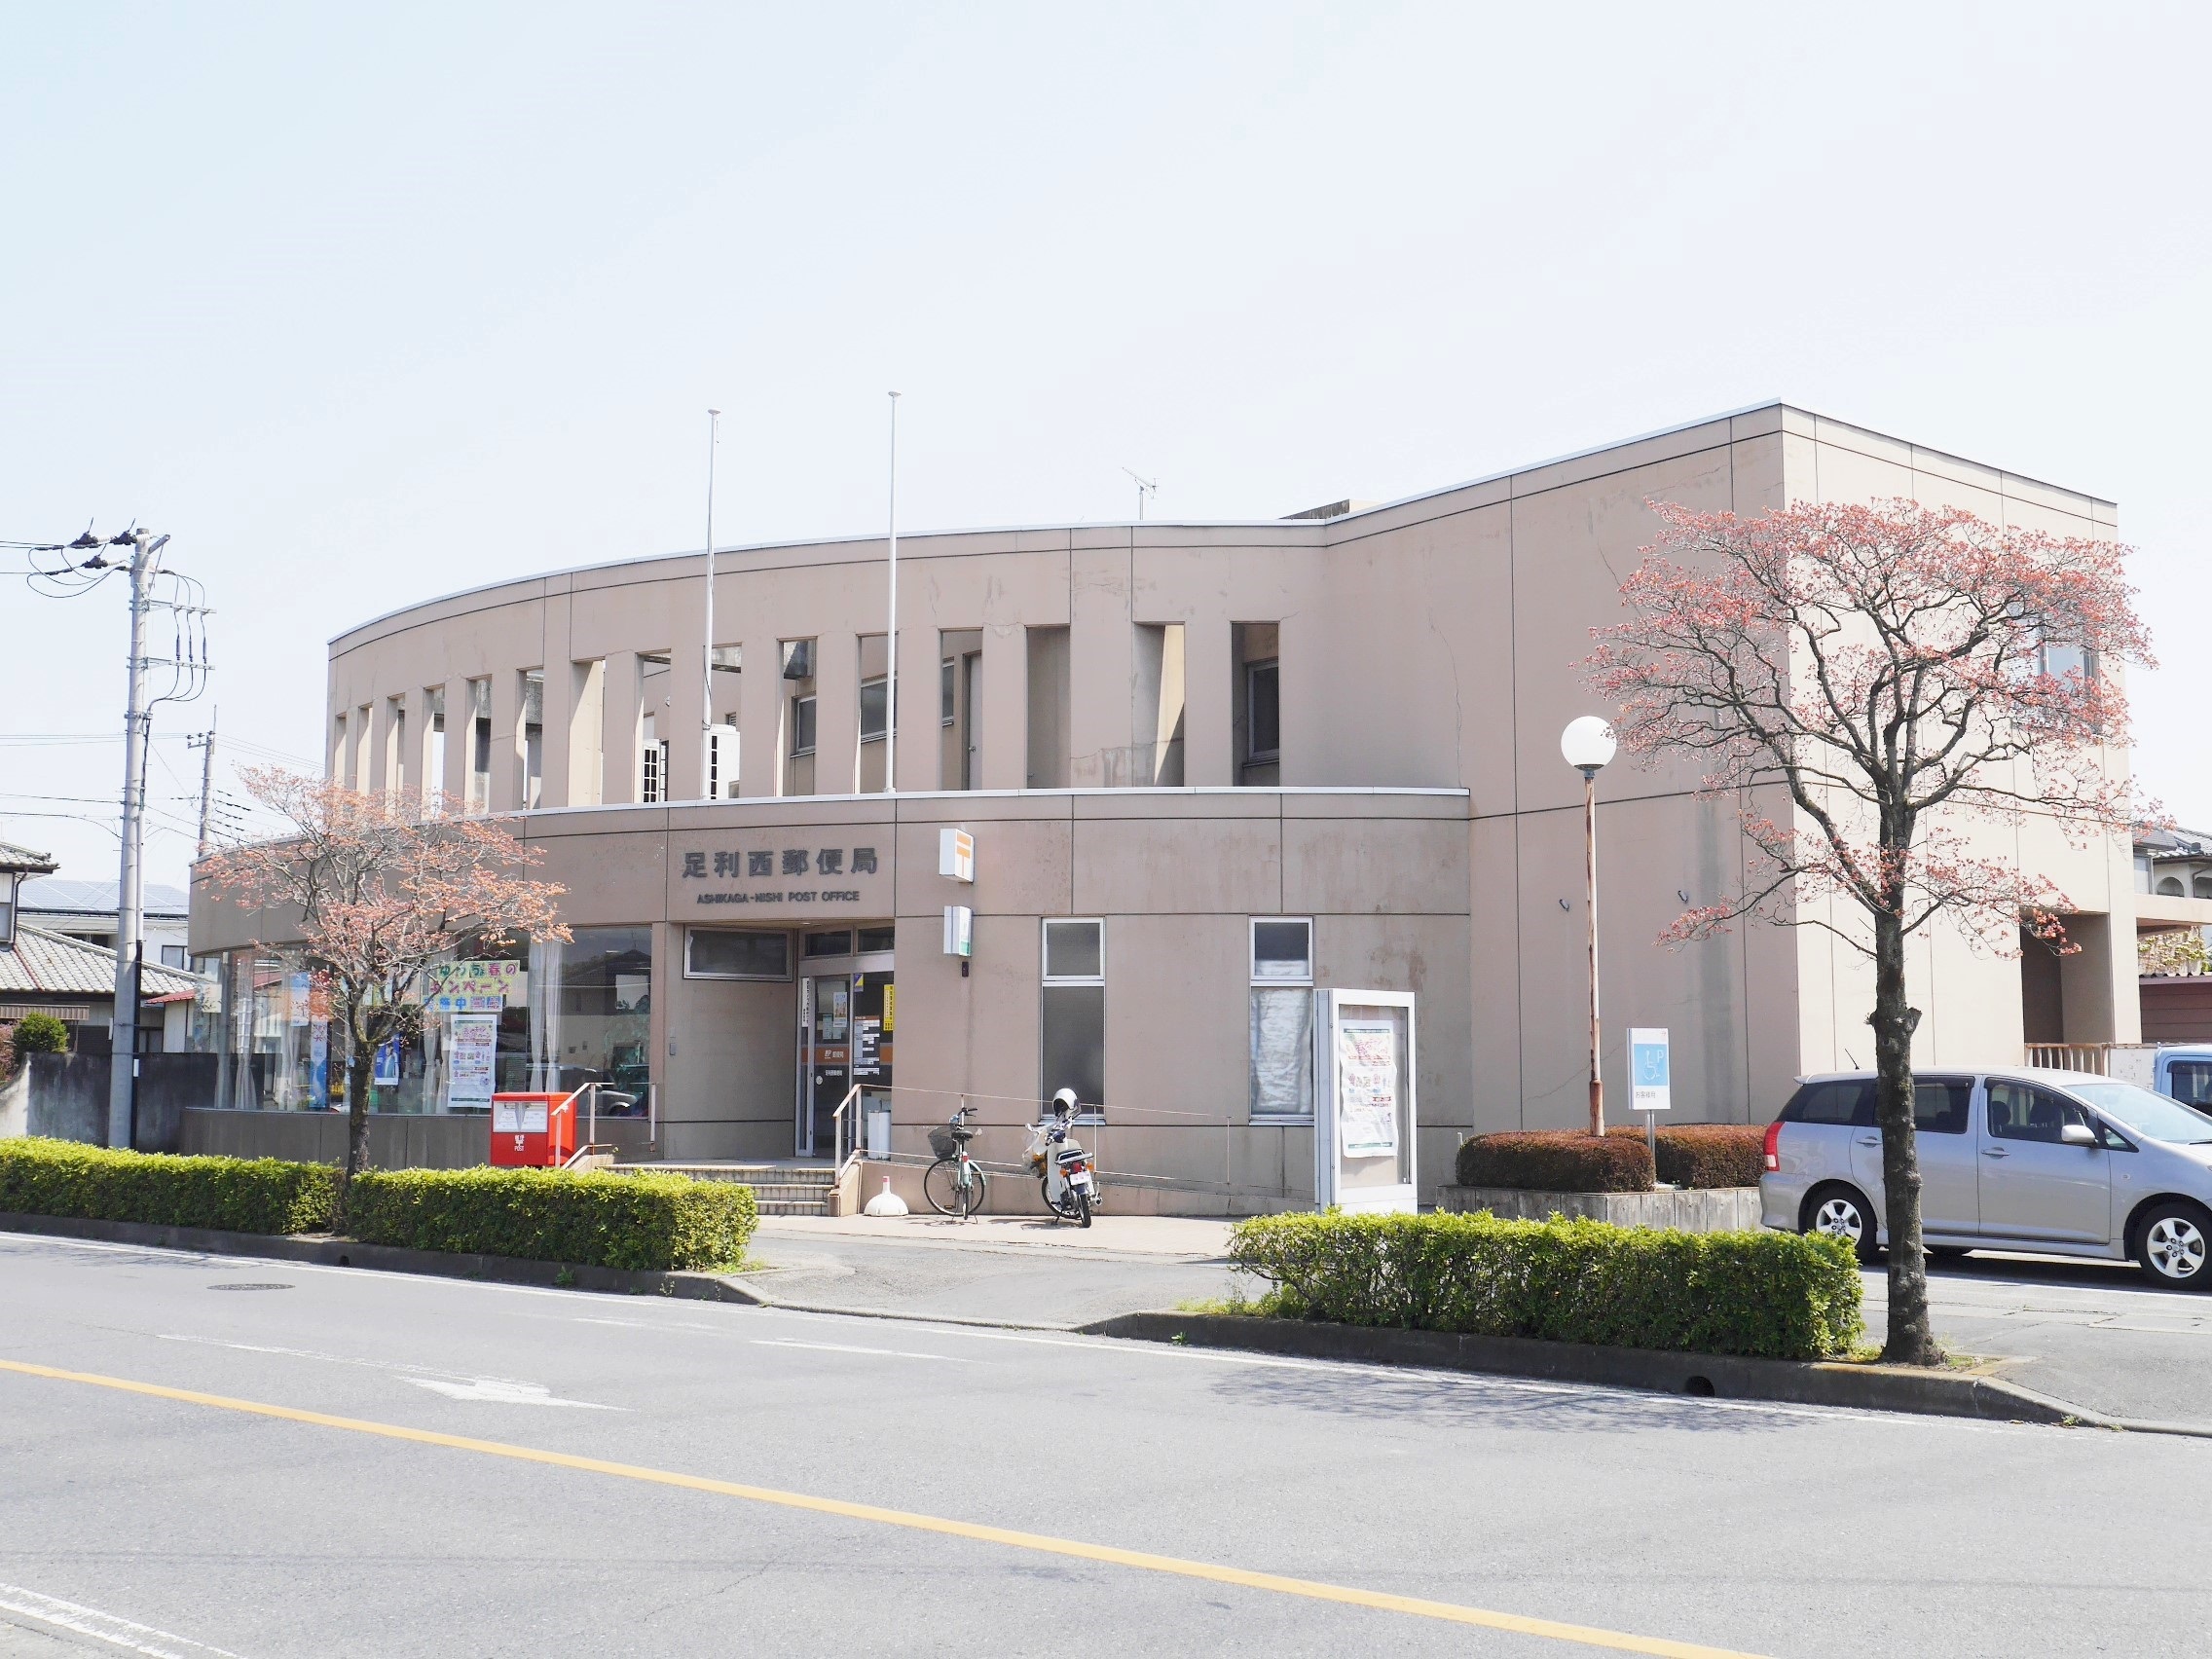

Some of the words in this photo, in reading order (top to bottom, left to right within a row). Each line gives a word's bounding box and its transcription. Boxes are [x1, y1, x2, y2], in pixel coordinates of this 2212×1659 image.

[682, 848, 877, 878] 足利西郵便局
[697, 892, 783, 904] ASHIKAGA-NISHI
[788, 891, 818, 903] POST
[821, 890, 860, 902] OFFICE
